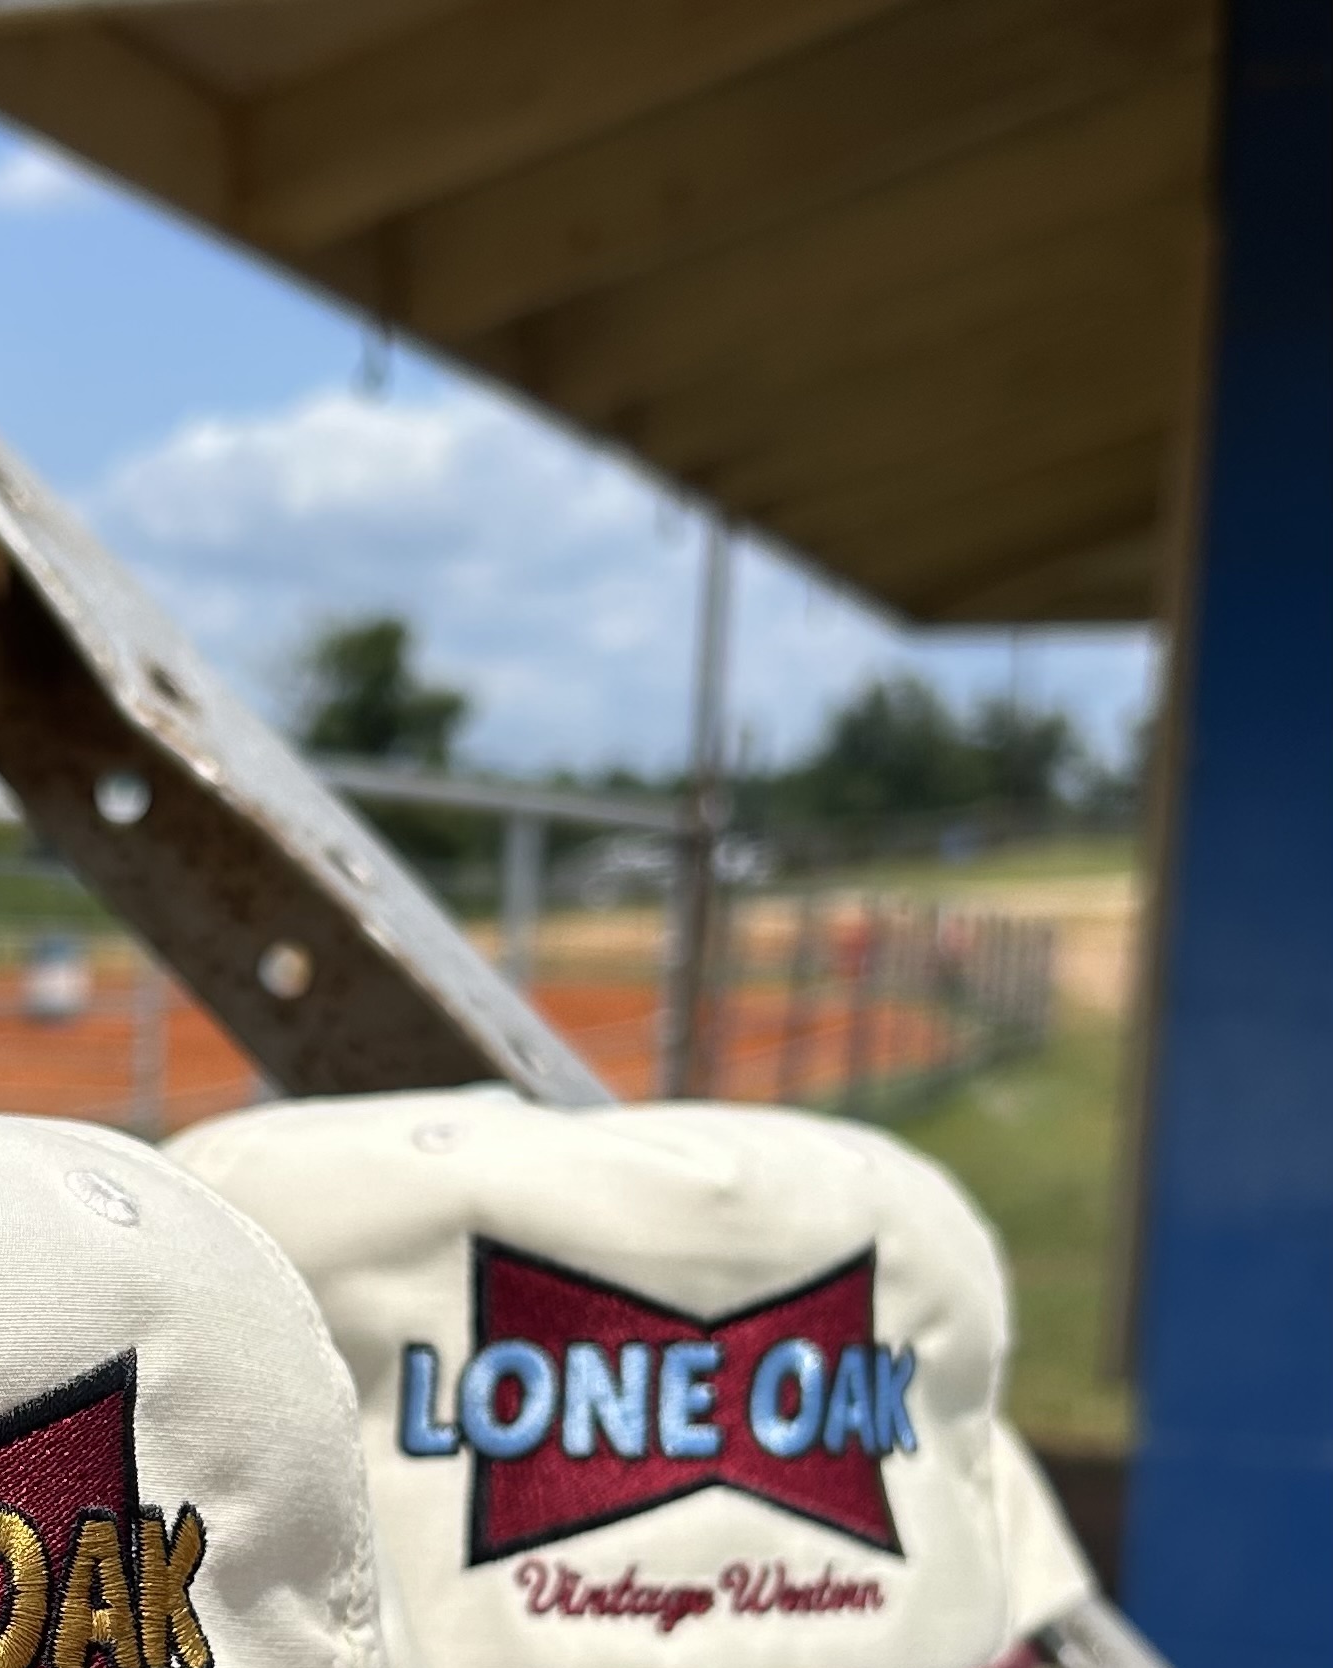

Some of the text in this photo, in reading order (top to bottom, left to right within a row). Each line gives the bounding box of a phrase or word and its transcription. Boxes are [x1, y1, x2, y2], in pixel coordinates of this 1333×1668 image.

[398, 1337, 917, 1460] LONE OAK
[514, 1557, 715, 1635] Vintage
